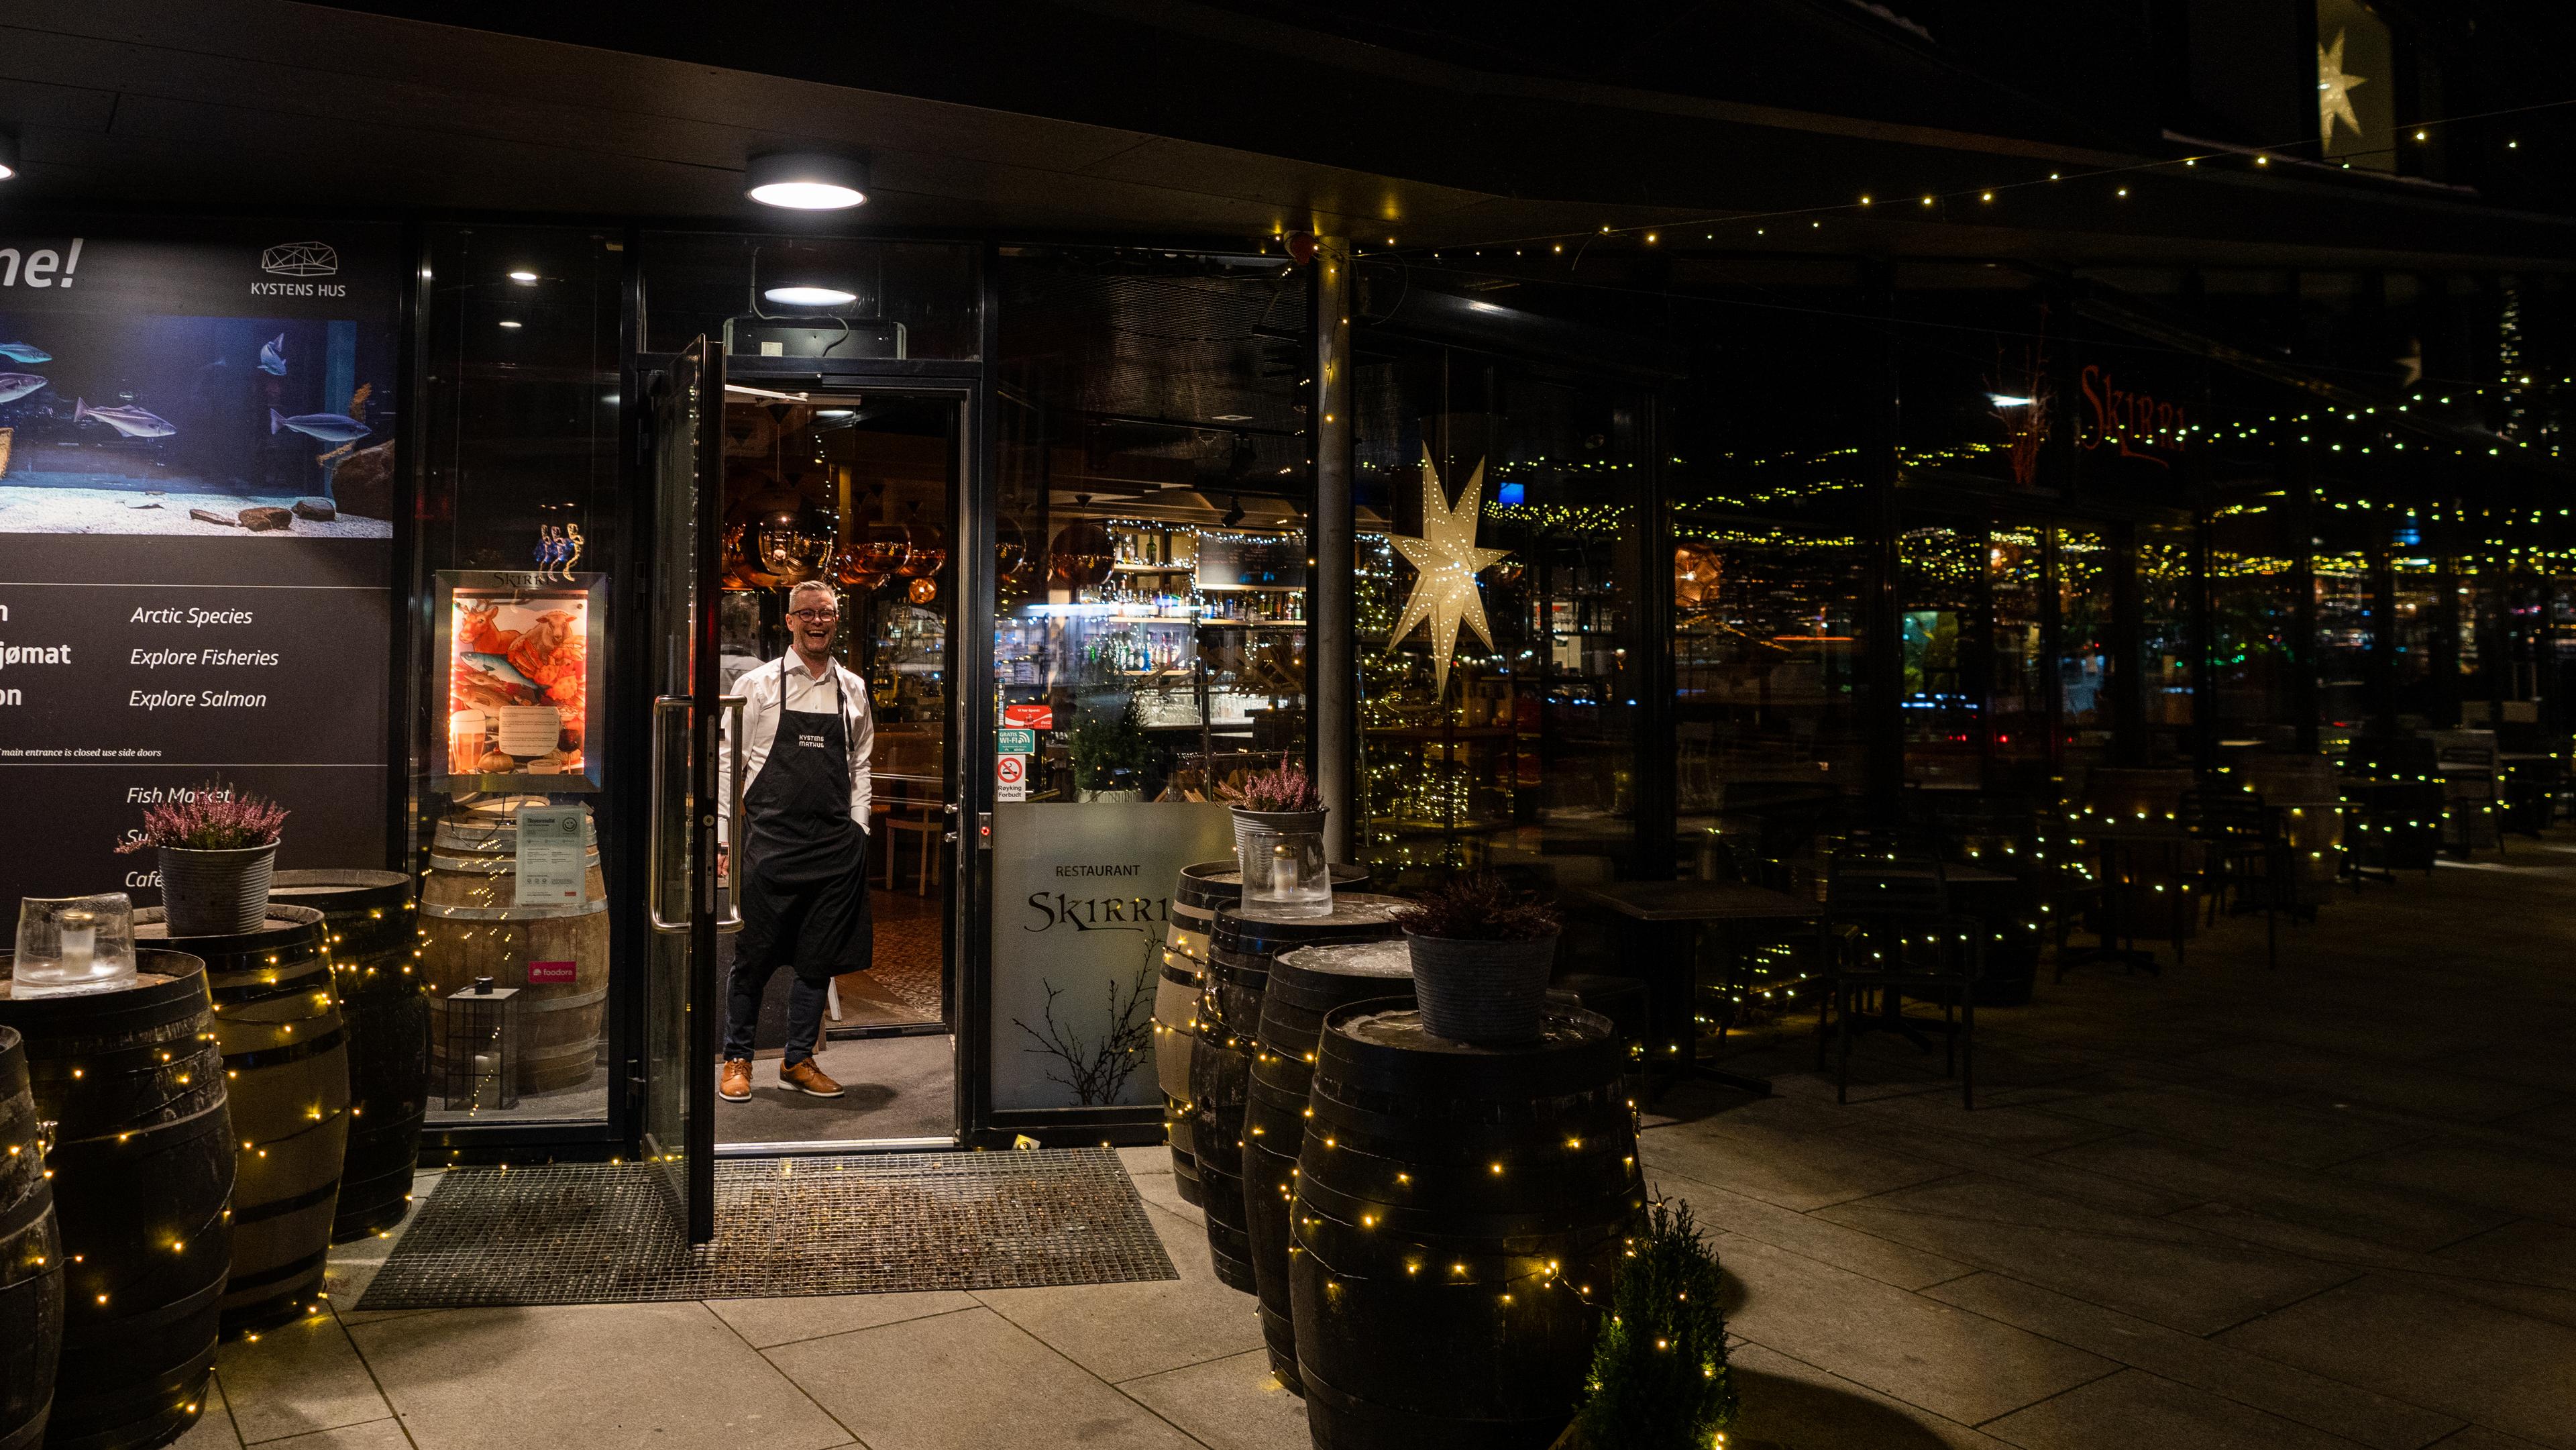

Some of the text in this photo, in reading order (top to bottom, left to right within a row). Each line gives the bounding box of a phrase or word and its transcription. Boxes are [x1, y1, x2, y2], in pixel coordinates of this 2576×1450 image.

[251, 282, 346, 297] KYSTENS HUS
[130, 607, 253, 627] Arctic Species
[130, 648, 280, 669] Explore Fisheries
[129, 690, 267, 711] Explore Salmon
[1, 748, 23, 756] main
[25, 749, 63, 757] entrance
[64, 748, 72, 756] is
[74, 748, 101, 757] closed
[118, 748, 136, 757] side
[137, 748, 162, 757] doors
[127, 787, 230, 803] Fish Maket
[1056, 864, 1140, 877] RESTAURANT
